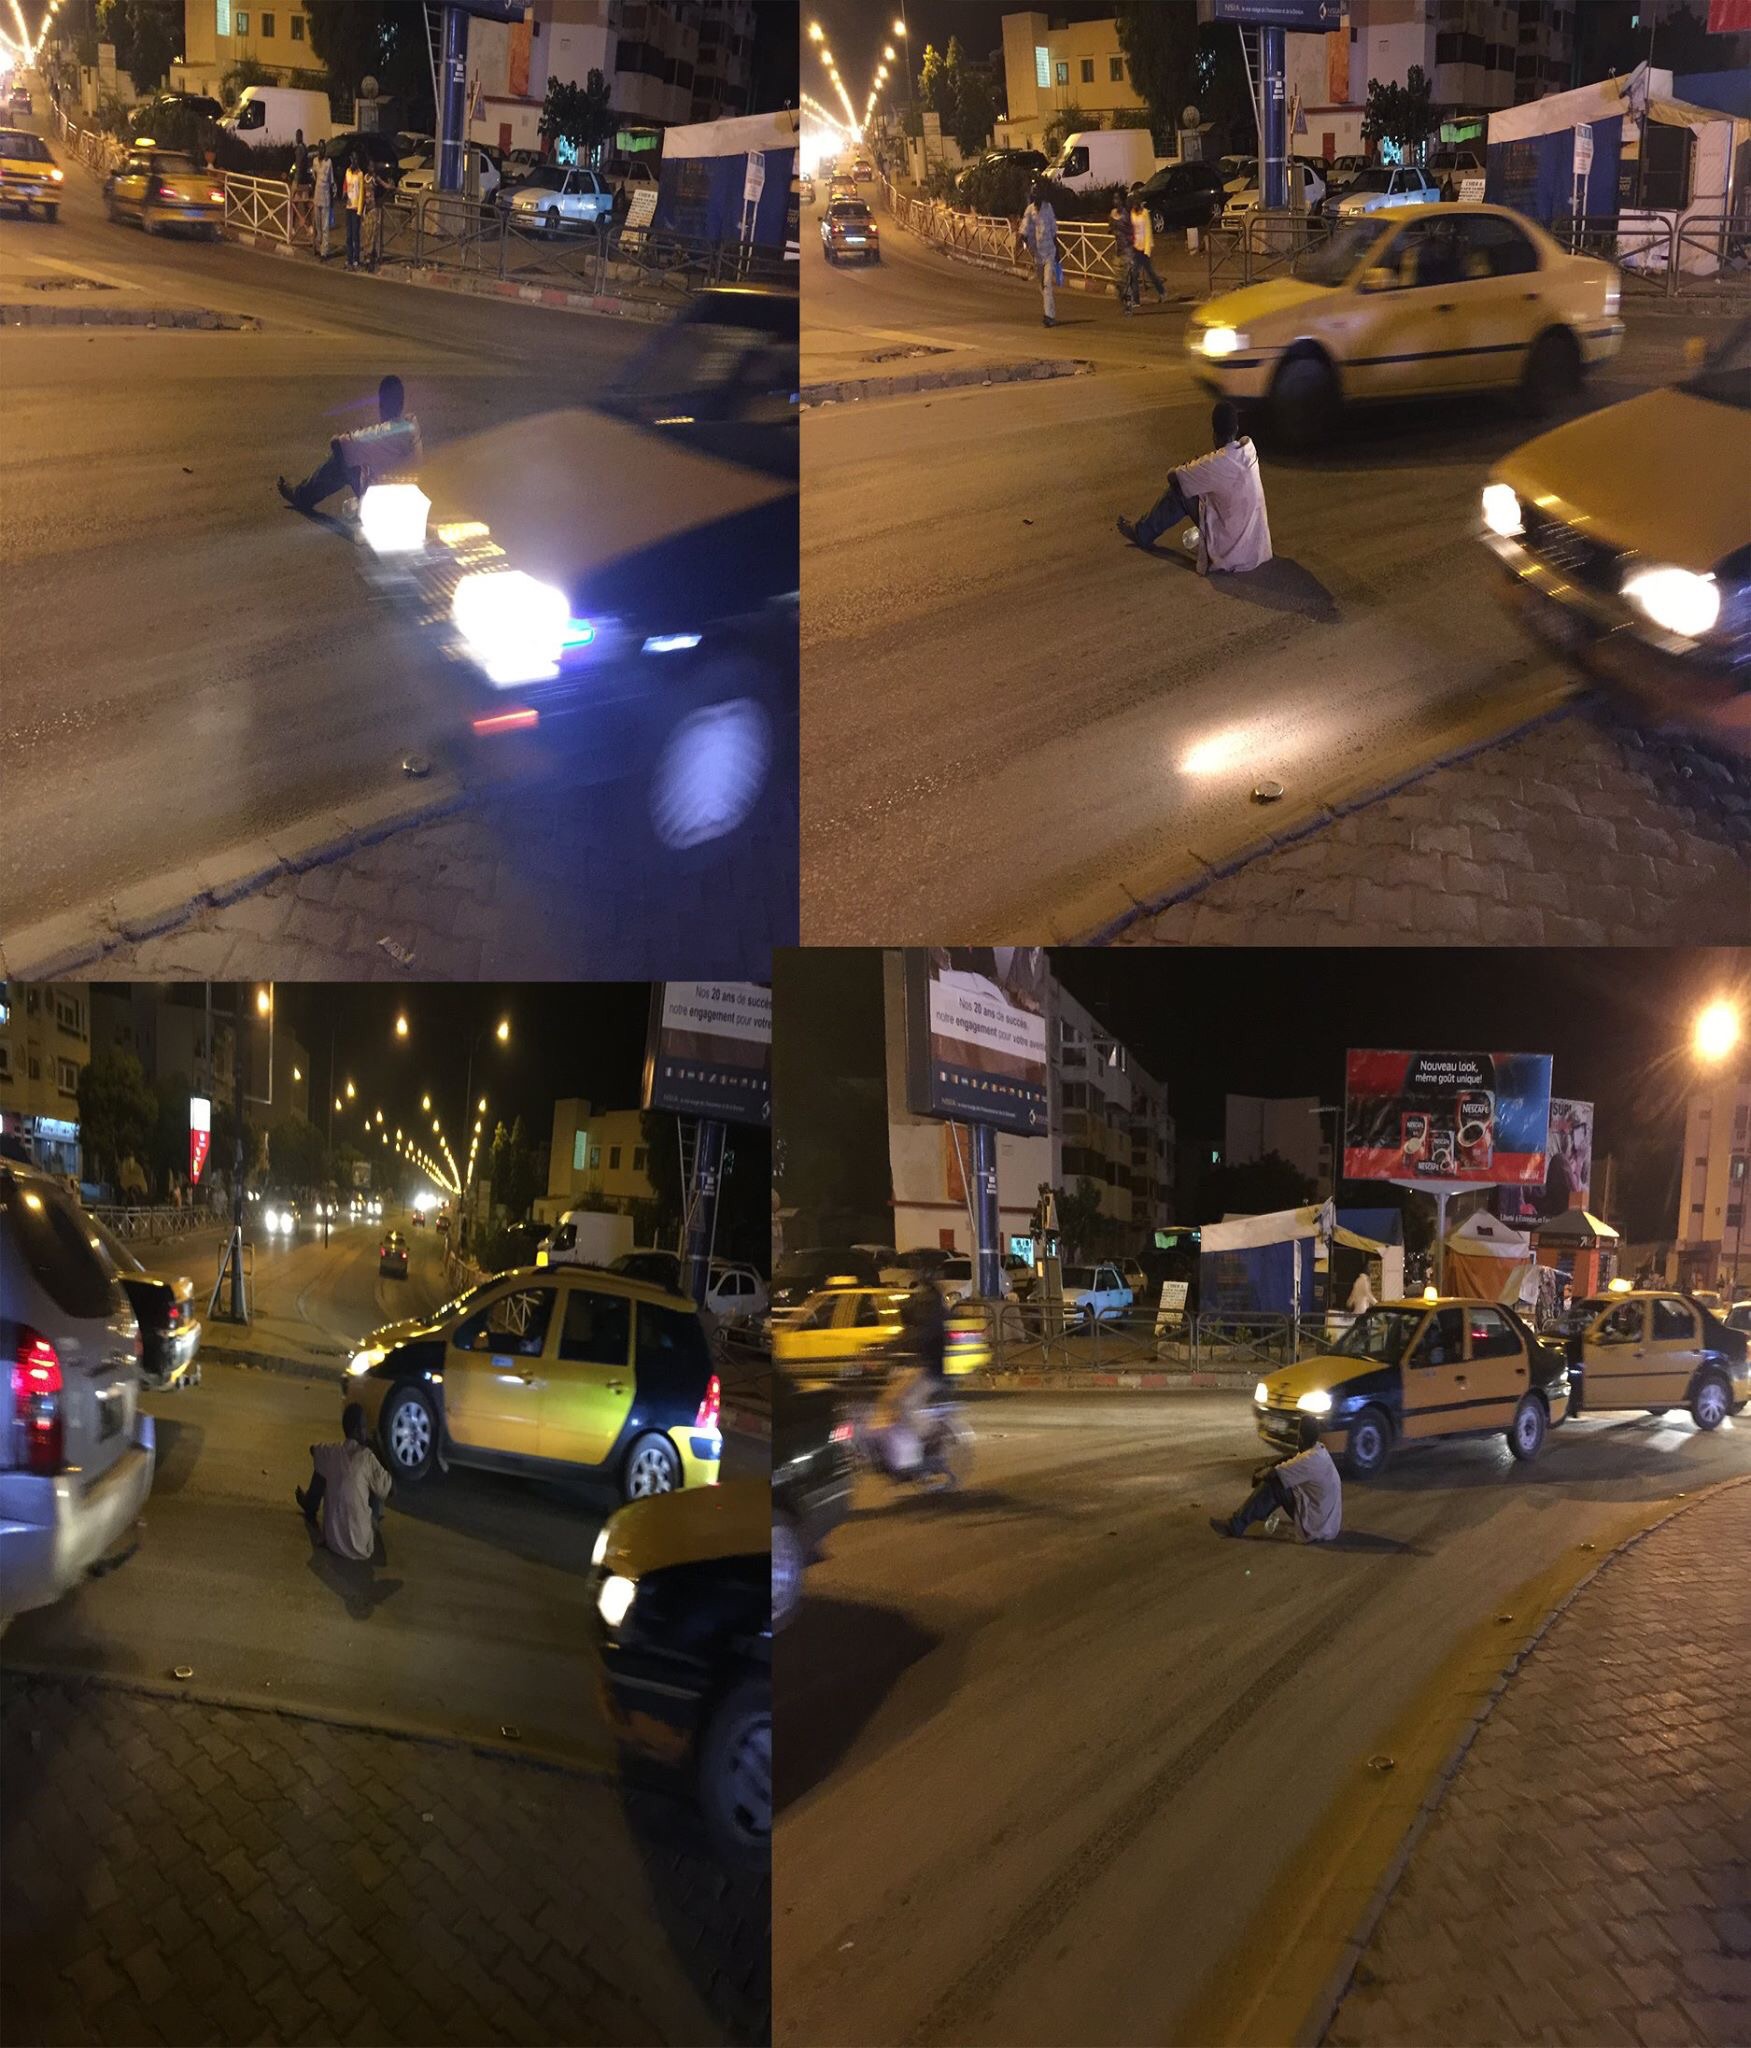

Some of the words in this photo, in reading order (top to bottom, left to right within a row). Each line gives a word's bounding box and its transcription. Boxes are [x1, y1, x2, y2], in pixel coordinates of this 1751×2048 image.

[696, 985, 710, 999] Nos
[711, 987, 721, 1000] 20
[722, 991, 735, 1003] ans
[737, 993, 746, 1006] de
[669, 1002, 688, 1016] notre
[689, 1006, 735, 1023] engagement
[736, 1014, 752, 1027] pour
[960, 998, 973, 1012] Nos
[973, 1002, 982, 1015] 20
[983, 1007, 996, 1020] ans
[996, 1010, 1005, 1022] de
[936, 1010, 954, 1025] notre
[955, 1017, 998, 1037] engagement
[998, 1028, 1012, 1041] pour
[1012, 1034, 1028, 1047] votre
[1420, 1060, 1457, 1072] Nouveau
[1458, 1061, 1479, 1073] look,
[1415, 1072, 1437, 1083] même
[1438, 1073, 1455, 1085] goût
[1456, 1074, 1483, 1086] unique!
